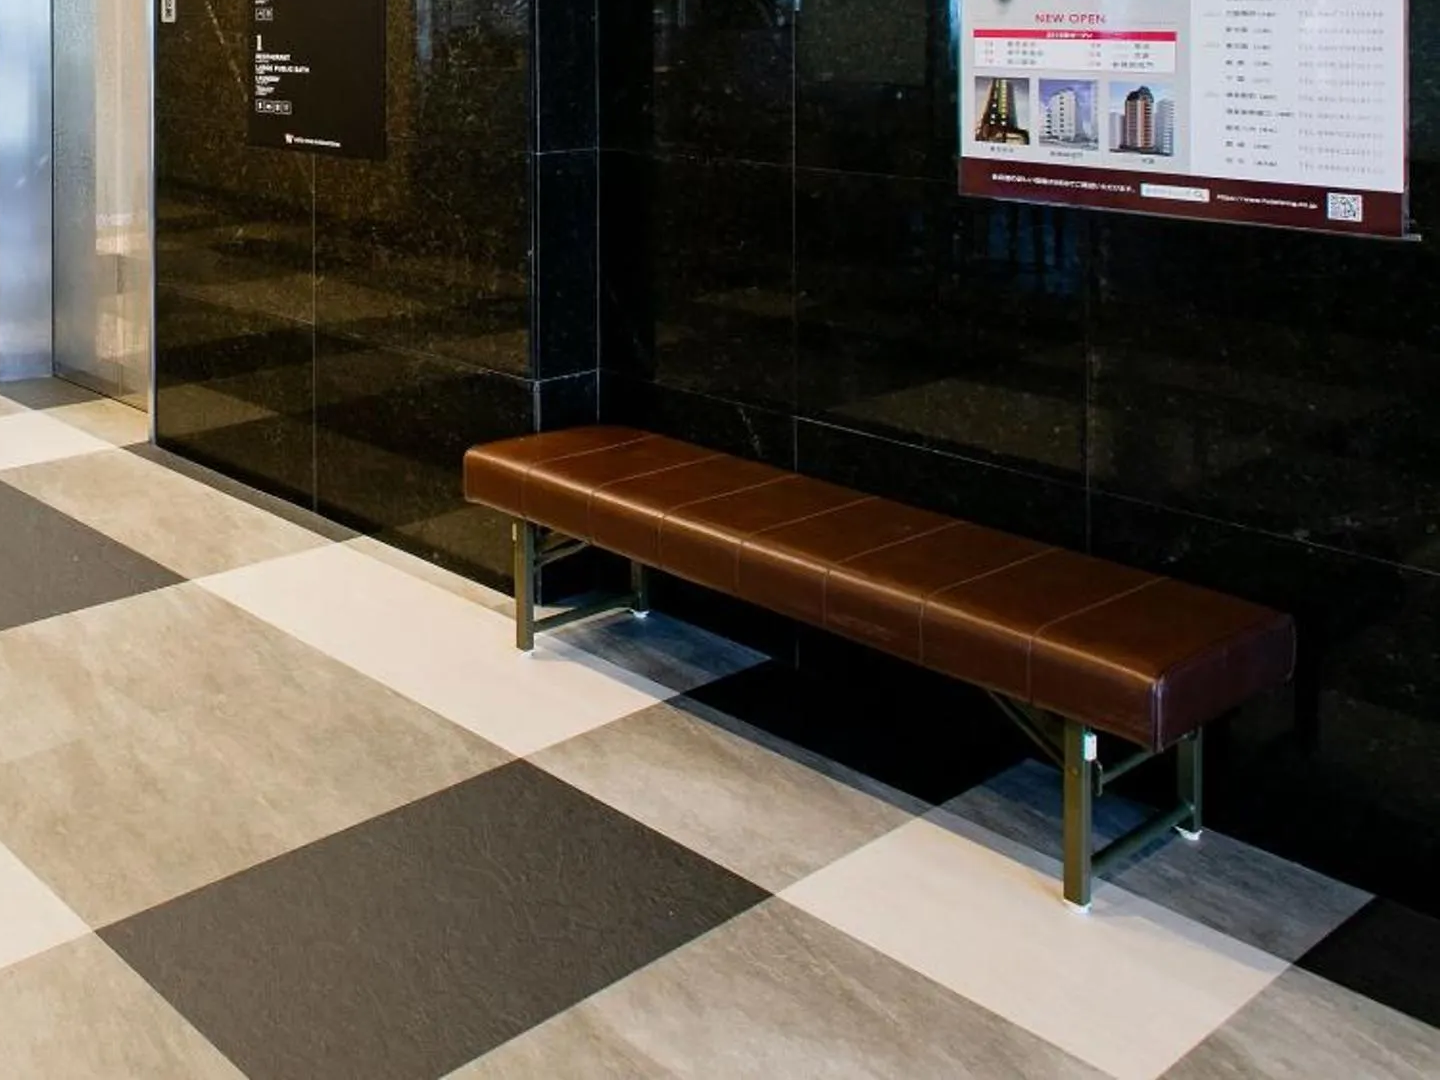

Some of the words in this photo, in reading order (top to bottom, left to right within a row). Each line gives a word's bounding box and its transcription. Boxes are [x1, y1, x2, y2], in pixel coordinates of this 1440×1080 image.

[1035, 13, 1065, 24] NEW
[1068, 13, 1106, 25] OPEN
[256, 34, 263, 52] 1
